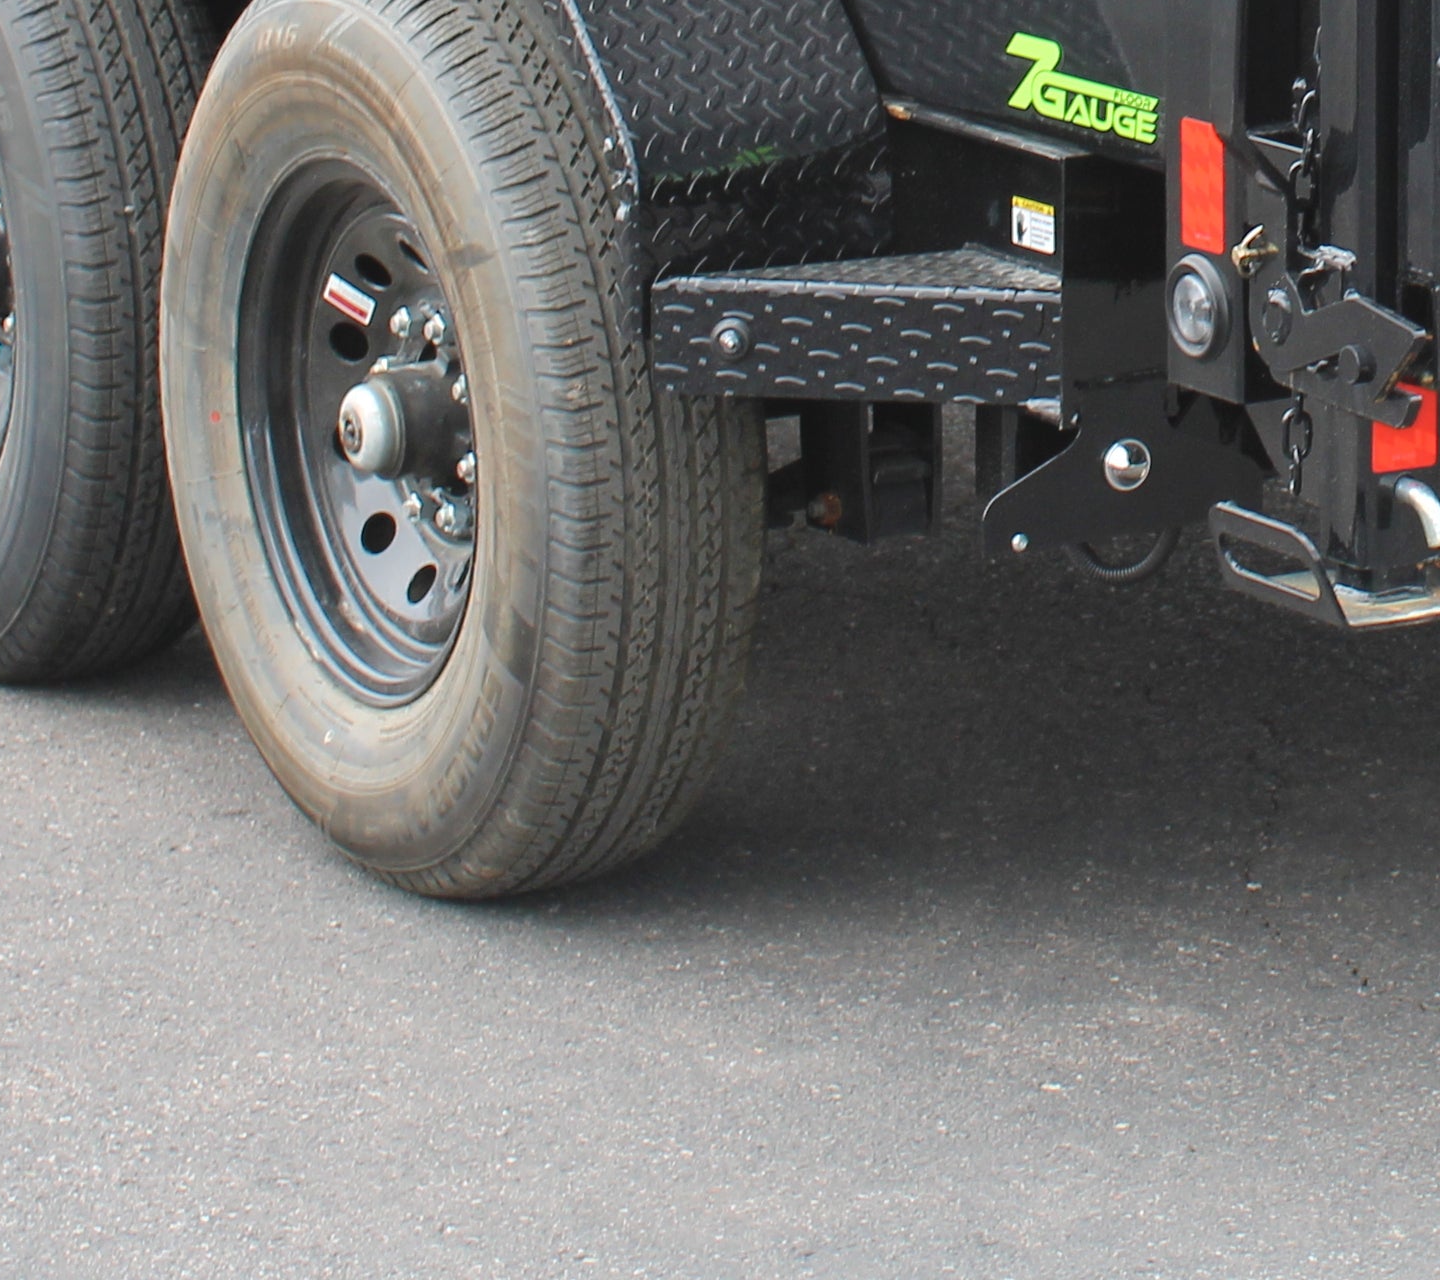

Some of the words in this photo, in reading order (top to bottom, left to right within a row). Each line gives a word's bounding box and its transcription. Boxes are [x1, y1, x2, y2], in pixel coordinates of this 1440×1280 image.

[1005, 31, 1062, 111] 7
[1031, 68, 1159, 145] GAUGE
[1114, 89, 1151, 111] FLOOR
